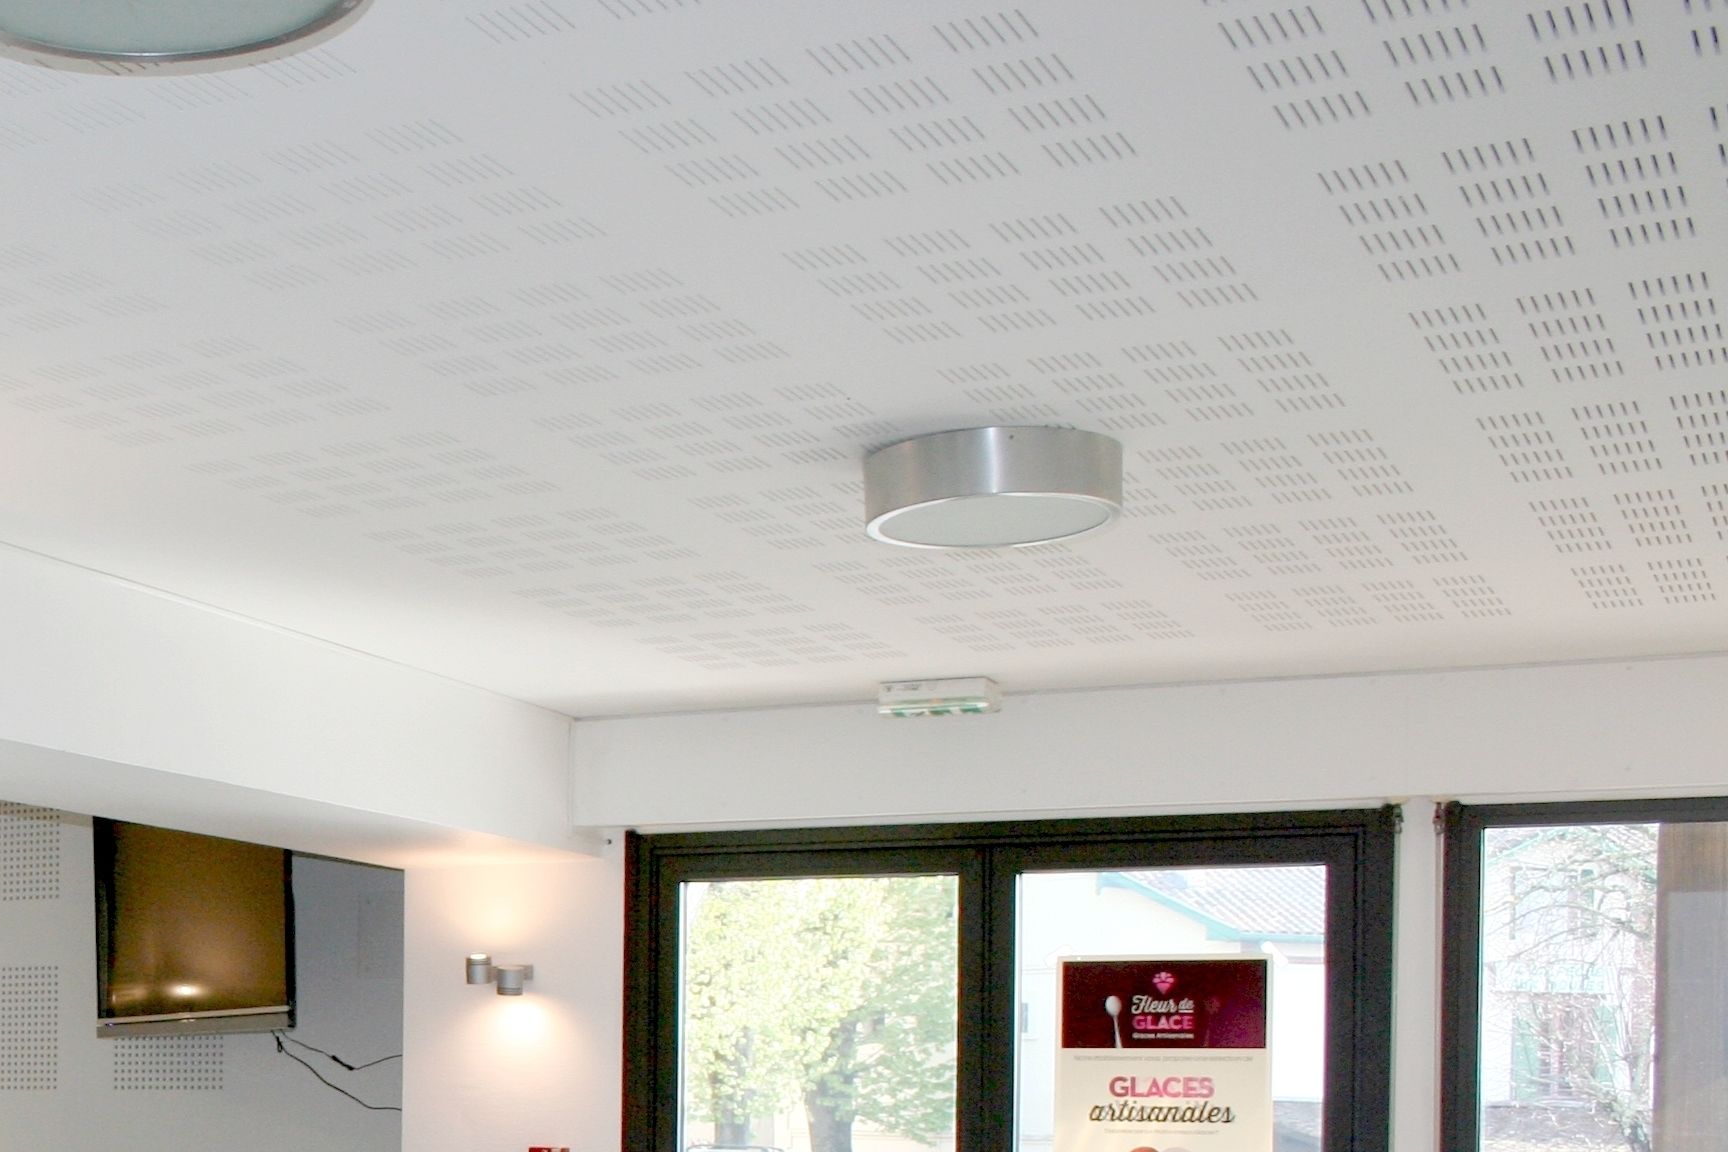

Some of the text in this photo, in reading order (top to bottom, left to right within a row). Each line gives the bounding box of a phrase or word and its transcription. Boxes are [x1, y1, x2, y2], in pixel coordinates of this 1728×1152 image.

[1131, 995, 1194, 1014] Fleur de
[1132, 1015, 1194, 1030] GLACE
[1109, 1076, 1214, 1098] GLACES
[1089, 1099, 1235, 1123] artisanales
